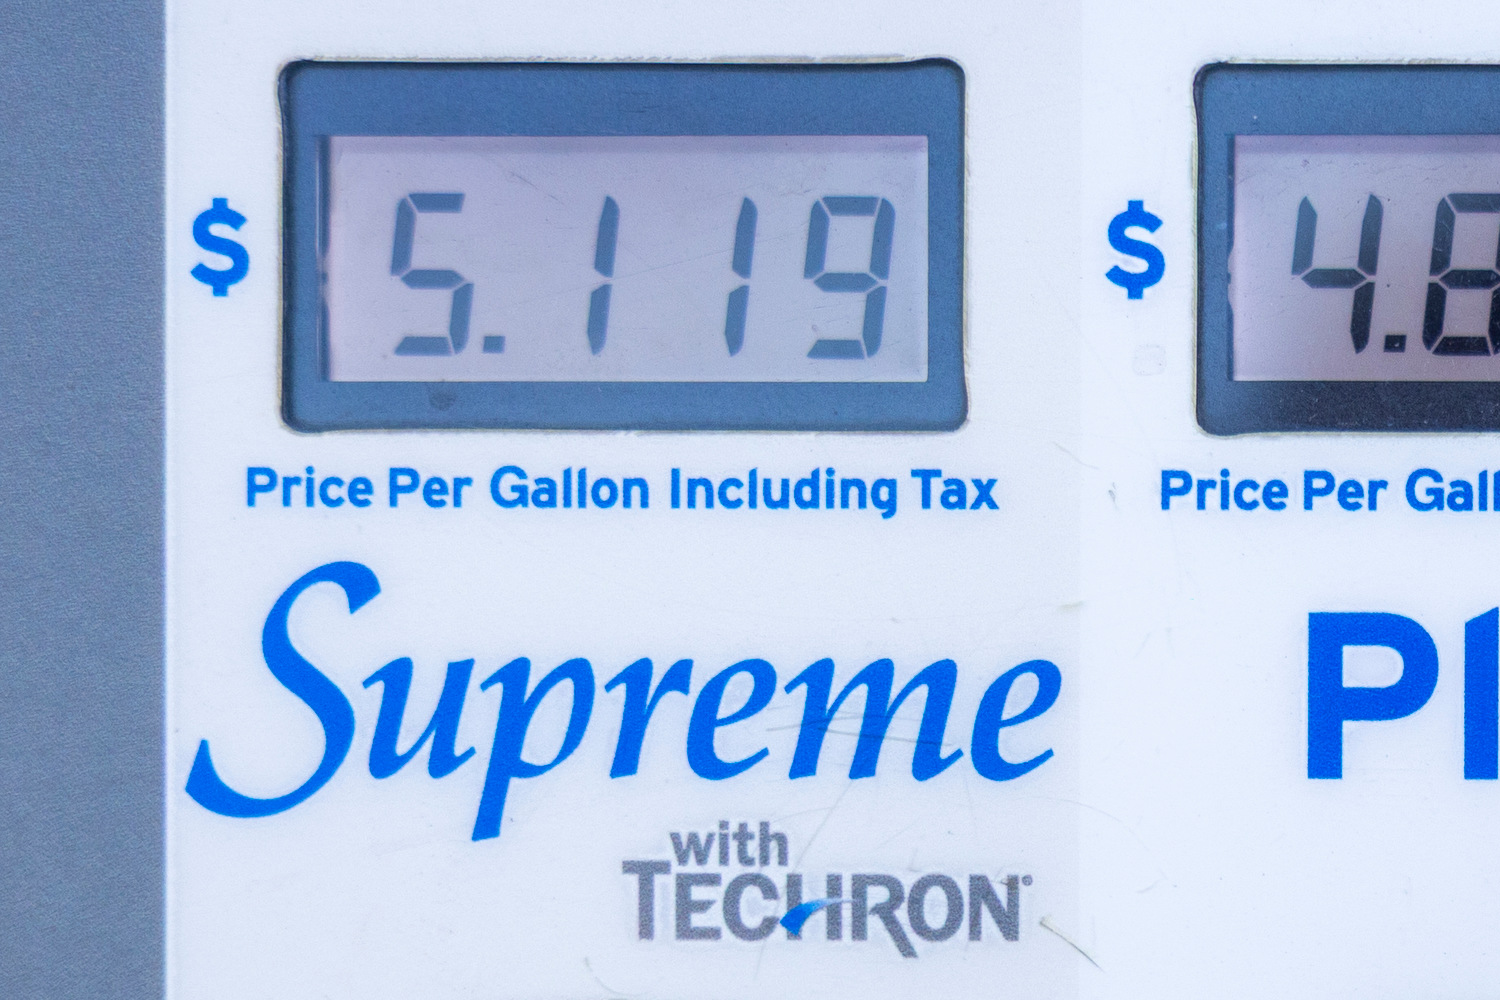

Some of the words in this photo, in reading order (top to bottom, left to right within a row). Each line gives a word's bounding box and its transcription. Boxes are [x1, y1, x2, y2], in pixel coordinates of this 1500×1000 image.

[190, 198, 249, 296] $
[391, 193, 896, 359] 5.119
[1105, 201, 1166, 299] $
[246, 466, 373, 509] Price
[389, 468, 472, 509] Per
[490, 466, 649, 509] Gallon
[670, 467, 897, 519] Including
[910, 470, 999, 510] Tax
[1160, 469, 1288, 512] Price
[1304, 470, 1388, 512] Per
[184, 561, 1062, 842] Supreme
[670, 822, 789, 867] with
